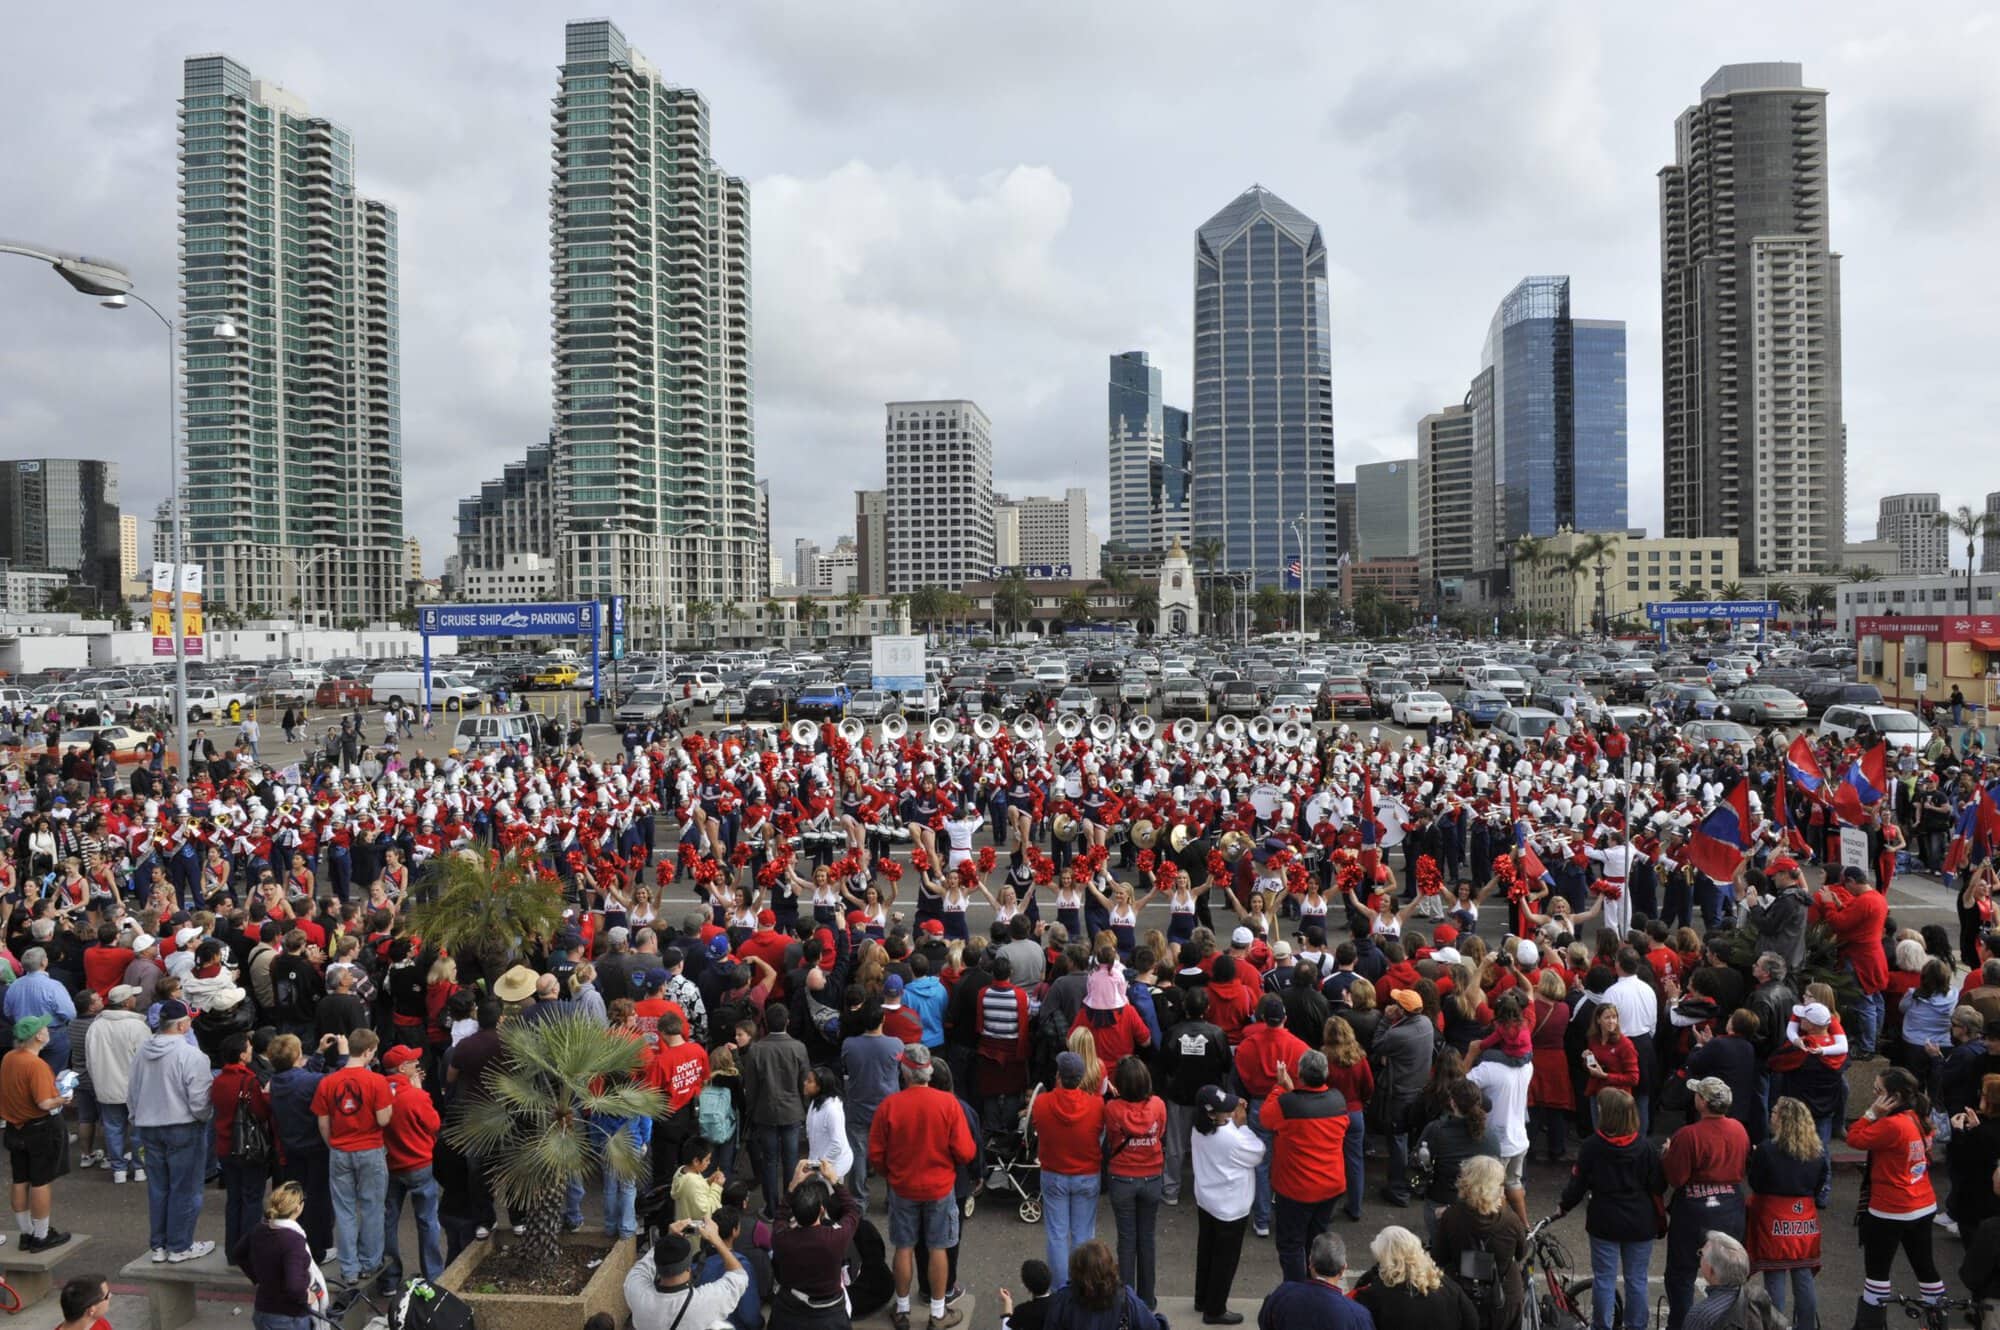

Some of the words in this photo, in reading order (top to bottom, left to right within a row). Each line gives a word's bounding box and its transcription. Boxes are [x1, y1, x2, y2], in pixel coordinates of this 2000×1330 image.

[992, 566, 1041, 577] Sata
[1051, 565, 1069, 577] Fe
[581, 608, 590, 620] 5
[1729, 605, 1764, 613] PARKING
[426, 611, 435, 624] 5
[440, 614, 477, 626] CRUISE
[479, 613, 502, 625] SHIP
[530, 612, 575, 625] PARKING
[615, 639, 622, 656] P
[1772, 1218, 1819, 1236] ARIZON
